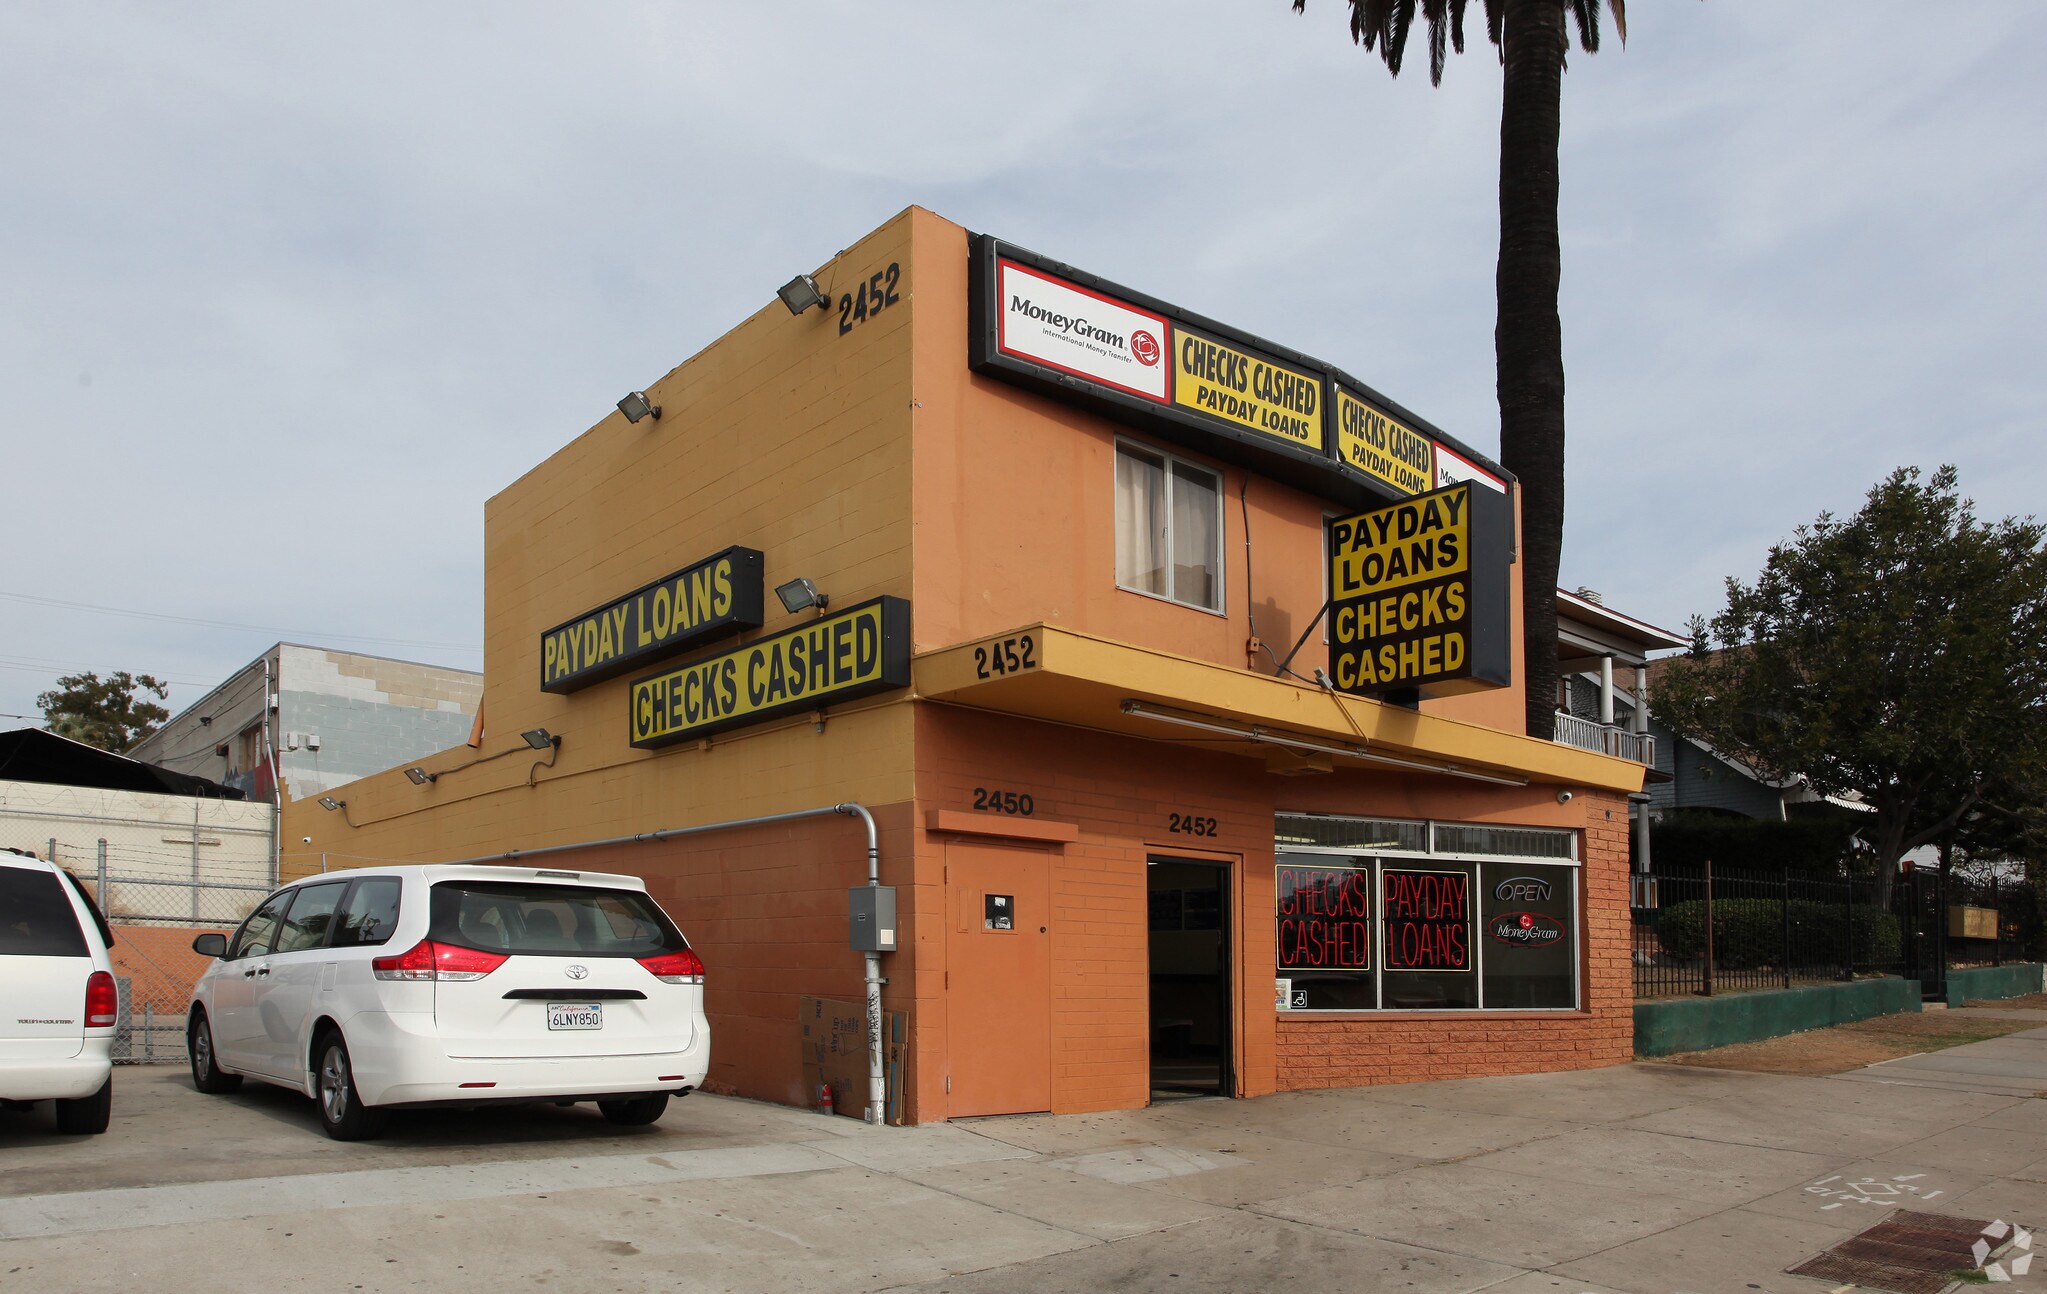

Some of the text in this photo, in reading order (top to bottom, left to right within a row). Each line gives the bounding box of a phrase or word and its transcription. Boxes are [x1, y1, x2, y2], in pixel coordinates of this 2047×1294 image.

[839, 262, 900, 337] 2452
[1010, 295, 1124, 349] MoneyGram
[1042, 327, 1132, 363] International Money Transfer
[1182, 337, 1316, 416] CHECKS CASHED
[1196, 385, 1309, 440] PAYDAY LOANS
[1342, 398, 1428, 474] CHECKS CASHED
[1352, 443, 1425, 493] PAYDAY LOANS
[1334, 489, 1467, 557] PAYDAY
[1343, 533, 1458, 592] LOANS
[544, 558, 733, 683] PAYDAY LOANS
[1336, 582, 1466, 644] CHECKS
[636, 613, 877, 737] CHECKS CASHED
[974, 635, 1036, 679] 2452
[1337, 632, 1465, 689] CASHED
[973, 787, 1034, 816] 2450
[1169, 813, 1217, 838] 2452
[1280, 870, 1366, 917] CHECKS
[1384, 874, 1466, 919] PAYDAY
[1500, 884, 1552, 901] OPEN
[1280, 919, 1367, 966] CASHED
[1390, 922, 1465, 966] LOANS
[1497, 924, 1558, 941] MoneyGram
[553, 1013, 598, 1026] 6LNY850
